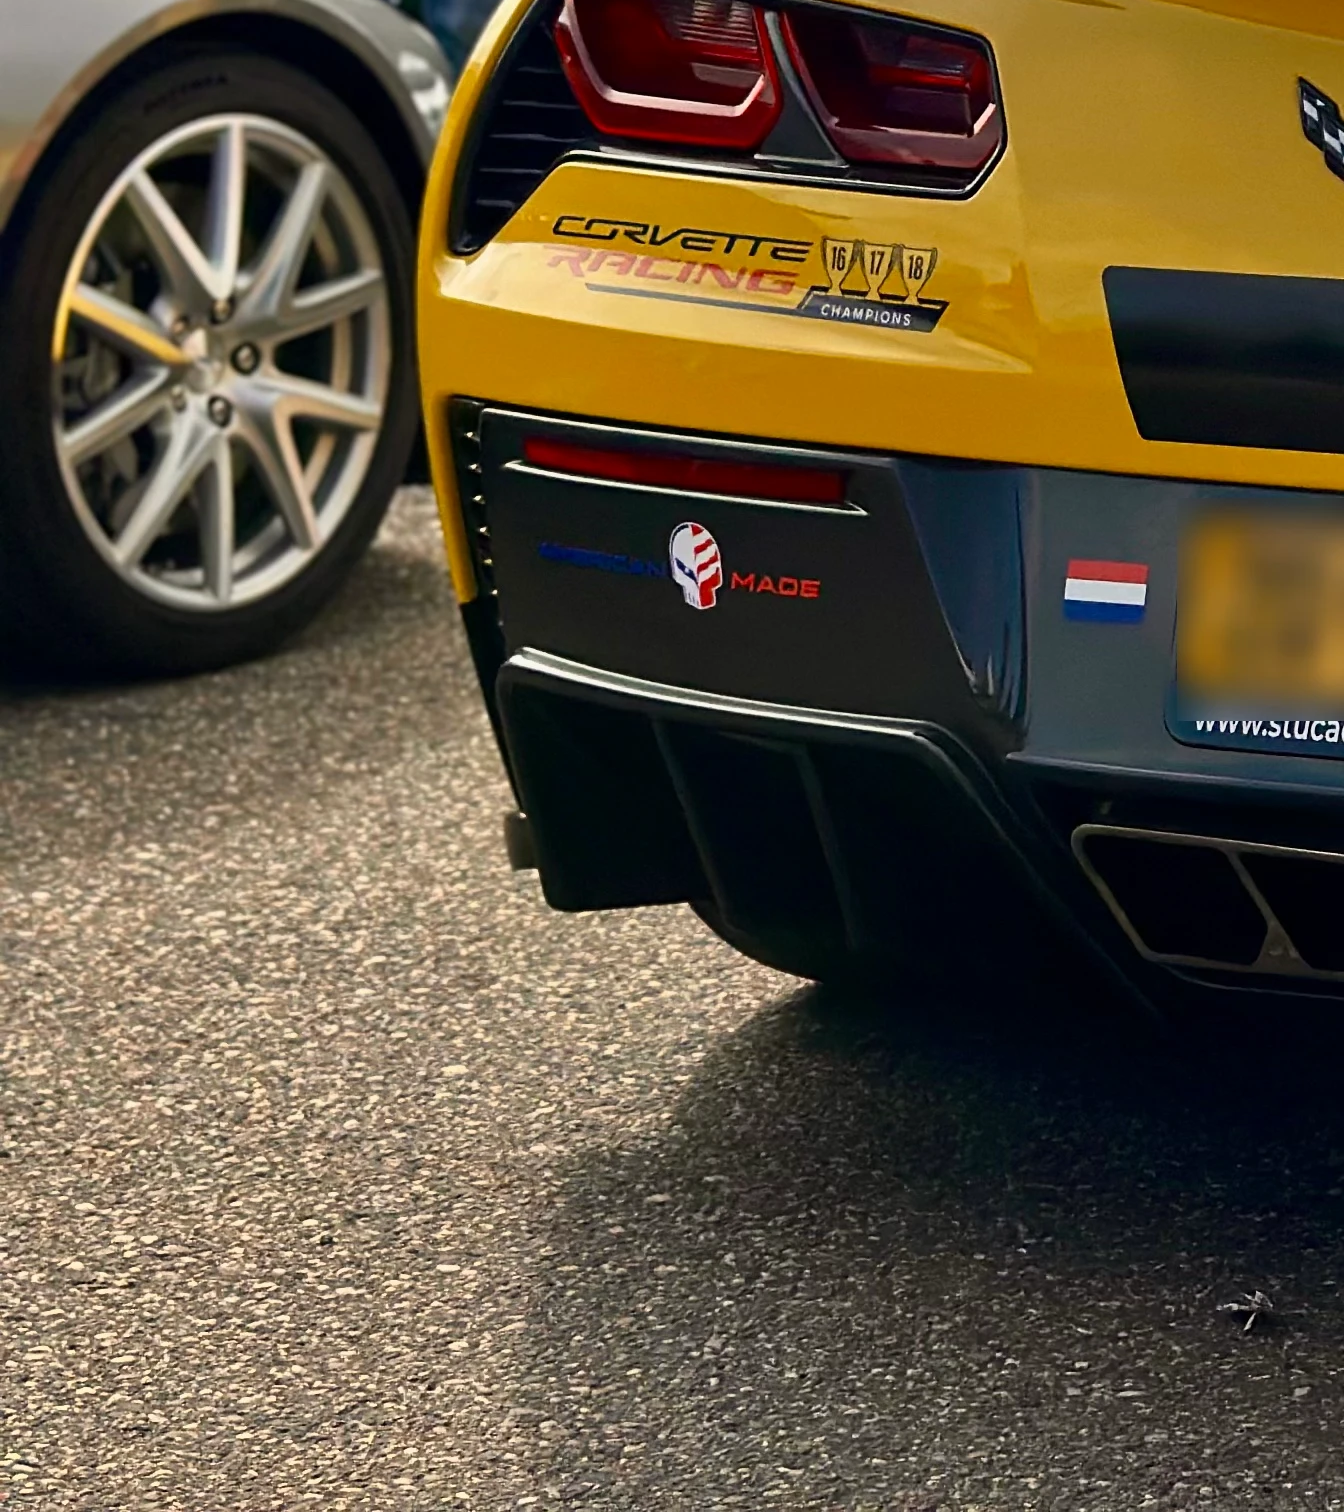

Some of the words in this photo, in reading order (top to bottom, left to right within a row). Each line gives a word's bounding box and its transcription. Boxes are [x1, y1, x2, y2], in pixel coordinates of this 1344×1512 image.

[552, 216, 814, 262] CORVETTE
[543, 243, 800, 296] RACING
[831, 245, 847, 271] 16
[869, 250, 885, 276] 17
[908, 254, 924, 280] 18
[821, 303, 912, 326] CHAMPIONS
[731, 572, 821, 598] MADE
